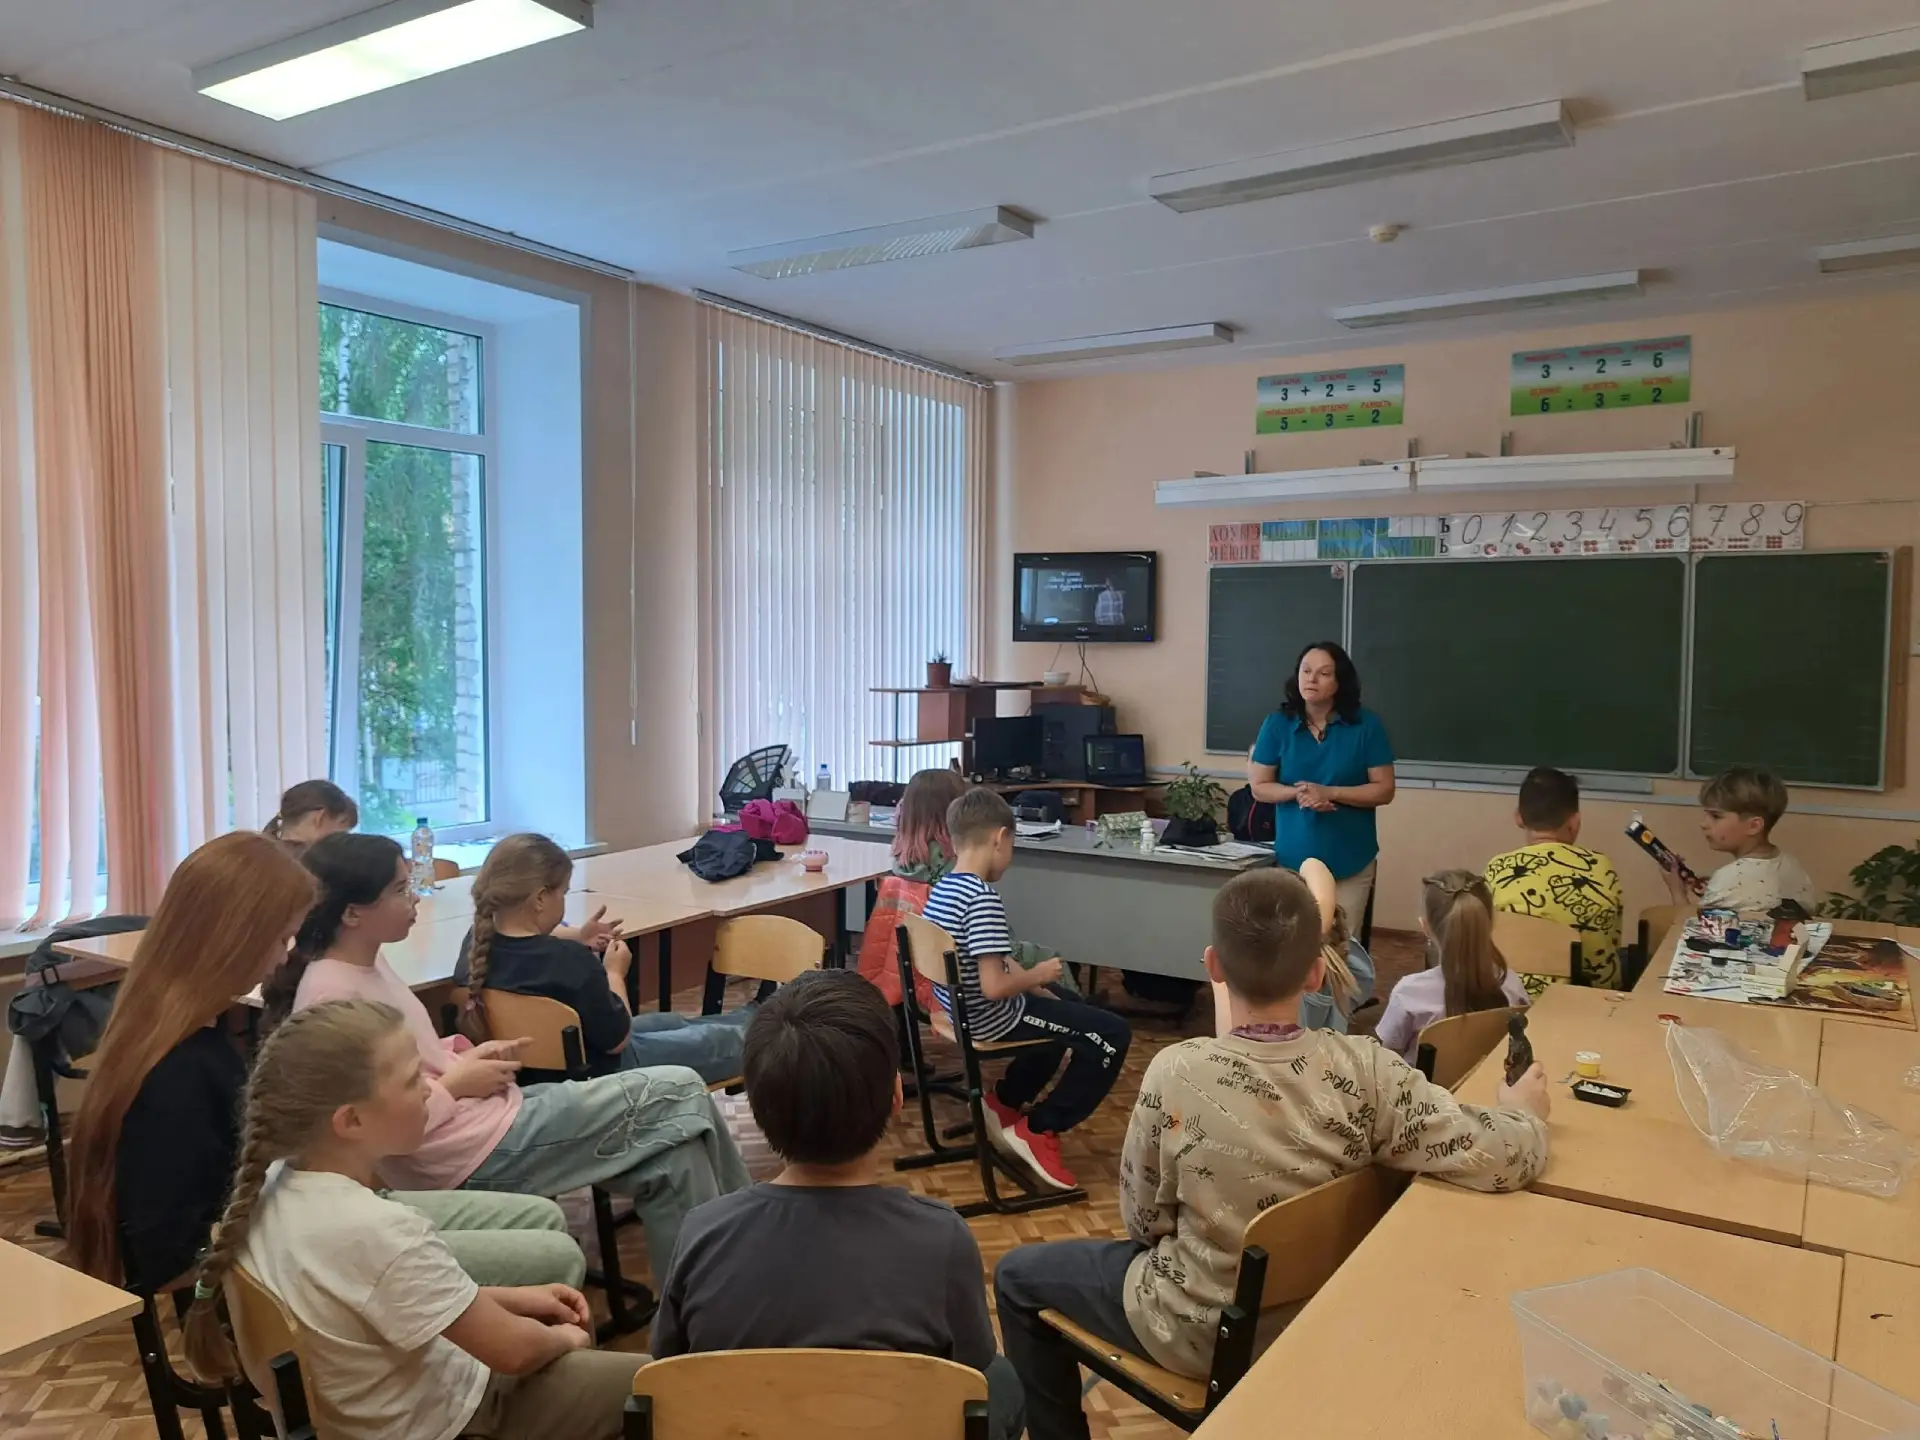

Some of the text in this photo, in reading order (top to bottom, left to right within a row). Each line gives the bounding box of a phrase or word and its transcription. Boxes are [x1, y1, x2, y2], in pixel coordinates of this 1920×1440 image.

[1541, 364, 1550, 379] 3
[1596, 358, 1606, 374] 2
[1653, 352, 1663, 368] 6
[1280, 387, 1288, 401] 3
[1325, 383, 1334, 397] 2
[1372, 378, 1381, 393] 5
[1541, 397, 1550, 412] 6
[1595, 392, 1604, 408] 3
[1651, 387, 1662, 403] 2
[1280, 416, 1288, 430] 5
[1325, 413, 1334, 427] 3
[1371, 409, 1380, 423] 2
[1461, 503, 1803, 544] 0 1 2 3 4 5 6 7 8 9
[1022, 1015, 1047, 1029] KEEP
[1425, 1133, 1473, 1162] STORIES
